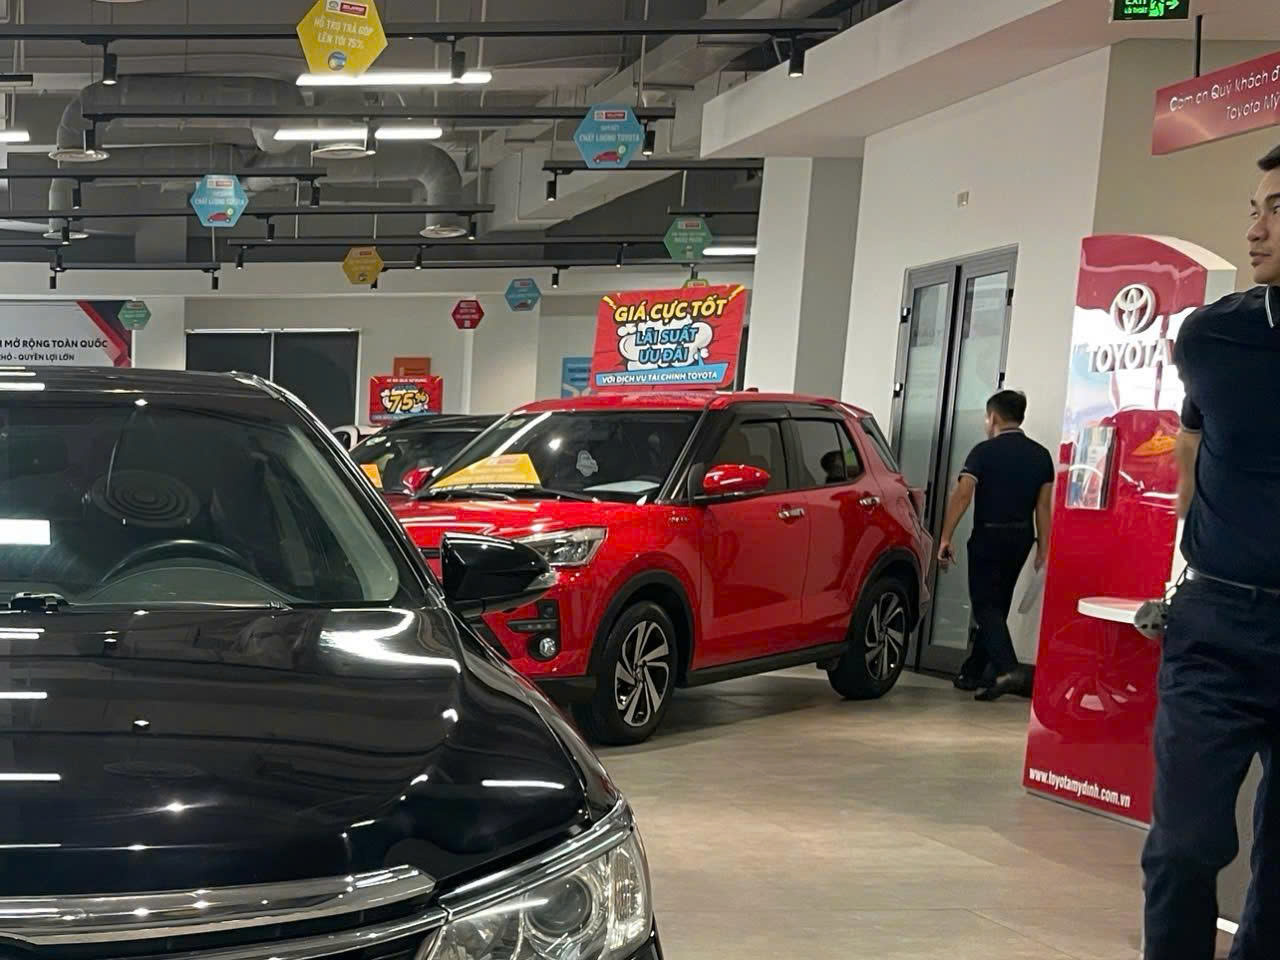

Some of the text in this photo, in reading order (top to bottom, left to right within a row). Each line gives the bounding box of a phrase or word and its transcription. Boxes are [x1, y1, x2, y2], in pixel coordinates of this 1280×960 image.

[1211, 80, 1232, 99] Quý
[1235, 70, 1269, 92] khách
[1226, 101, 1261, 120] Toyota
[614, 294, 728, 324] GIÁ CỰC TỐT
[4, 337, 21, 348] MỞ
[22, 337, 50, 350] RỘNG
[52, 337, 78, 348] TOÀN
[80, 337, 108, 348] QUỐC
[635, 324, 699, 347] LÃI SUẤT
[18, 352, 44, 361] QUYỀN
[639, 346, 660, 364] ƯU
[1086, 339, 1171, 373] TOYOTA
[617, 374, 635, 385] DỊCH
[660, 371, 686, 381] CHÍNH
[687, 371, 718, 380] TOYOTA
[1028, 767, 1131, 808] www.toyotamydinh.com.vn
